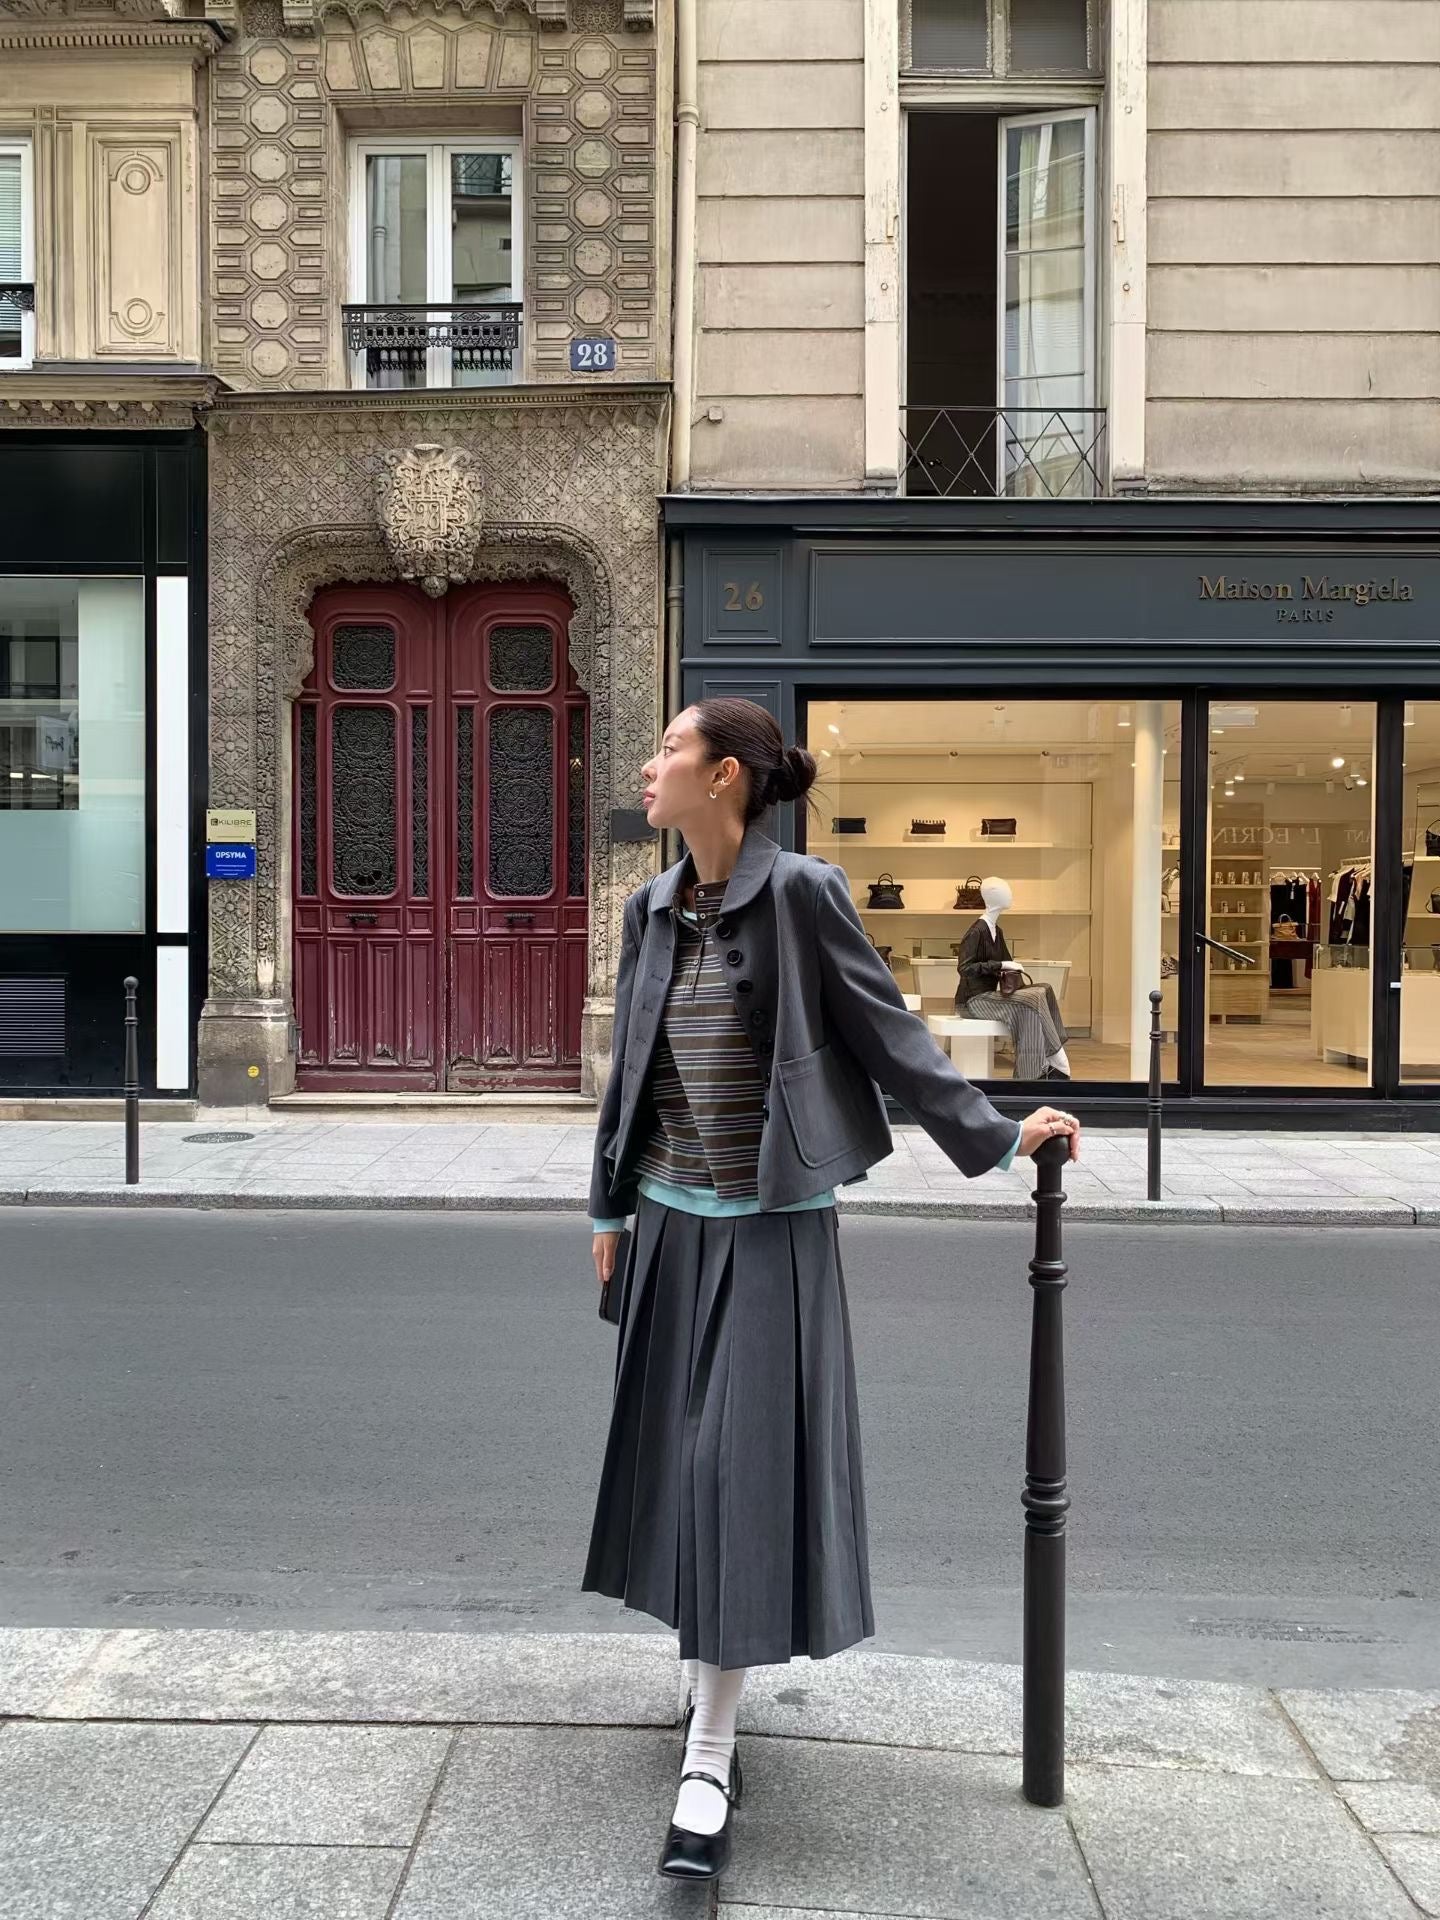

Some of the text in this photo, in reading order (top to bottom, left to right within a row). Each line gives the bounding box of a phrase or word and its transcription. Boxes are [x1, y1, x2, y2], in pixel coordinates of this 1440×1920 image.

[577, 343, 608, 367] 28
[722, 582, 764, 611] 26
[1199, 575, 1415, 606] Maison Margiela
[1277, 608, 1336, 623] PARIS
[215, 851, 247, 859] OPSYMA
